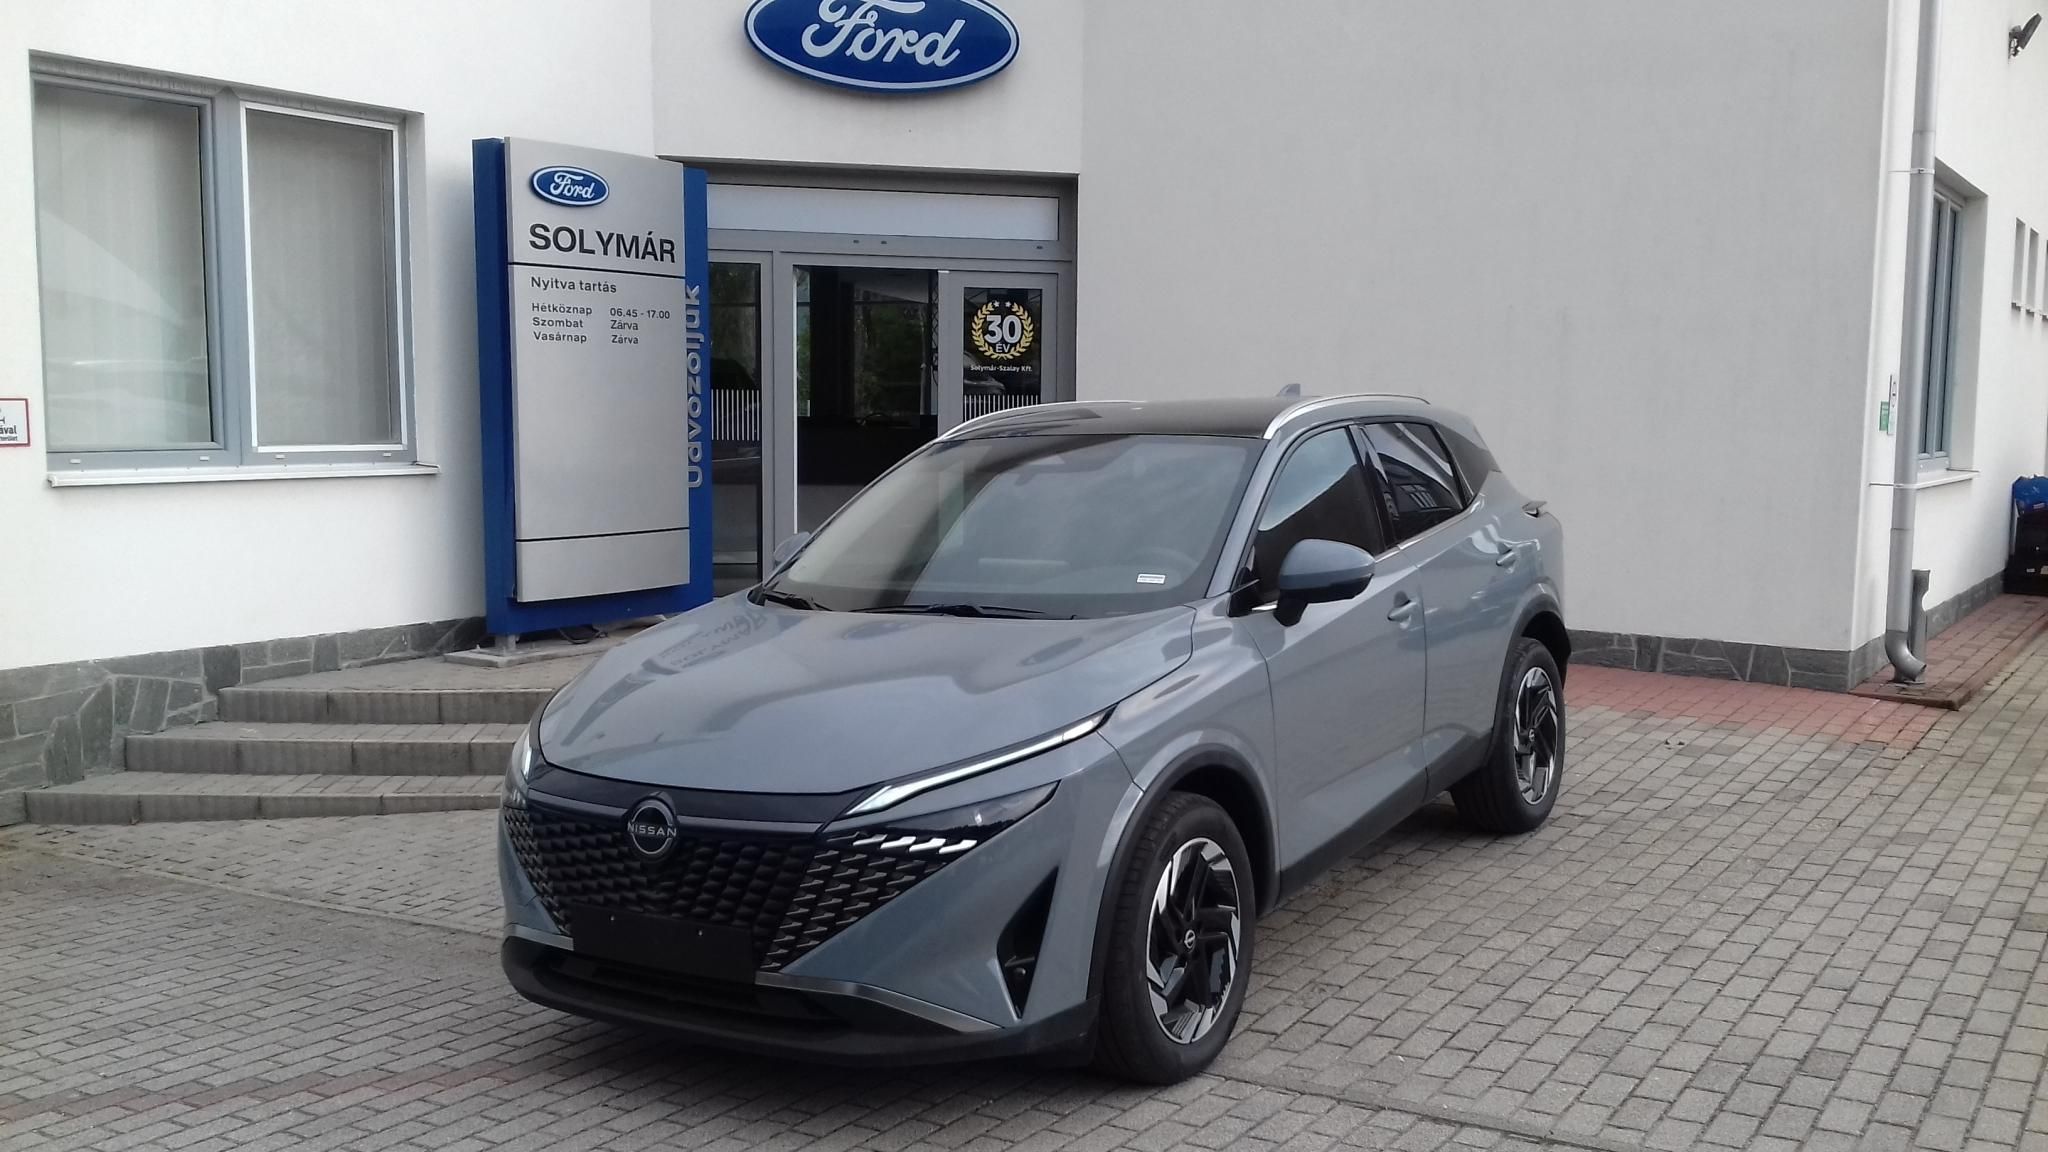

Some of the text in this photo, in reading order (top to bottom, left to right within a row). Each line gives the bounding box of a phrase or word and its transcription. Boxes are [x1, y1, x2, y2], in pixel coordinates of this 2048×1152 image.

[801, 0, 966, 67] Ford
[549, 172, 595, 199] Ford
[529, 223, 676, 264] SOLYMÁR
[531, 276, 617, 293] Nyitva tartás
[532, 303, 593, 316] Hétköznap
[610, 308, 638, 318] 06.45
[647, 310, 670, 319] 17.00
[532, 316, 638, 330] Szombat Zárva
[984, 315, 1022, 344] 30
[534, 331, 639, 345] Vasárnap Zárva
[996, 342, 1010, 352] ÉV
[627, 822, 677, 836] NISSAN
